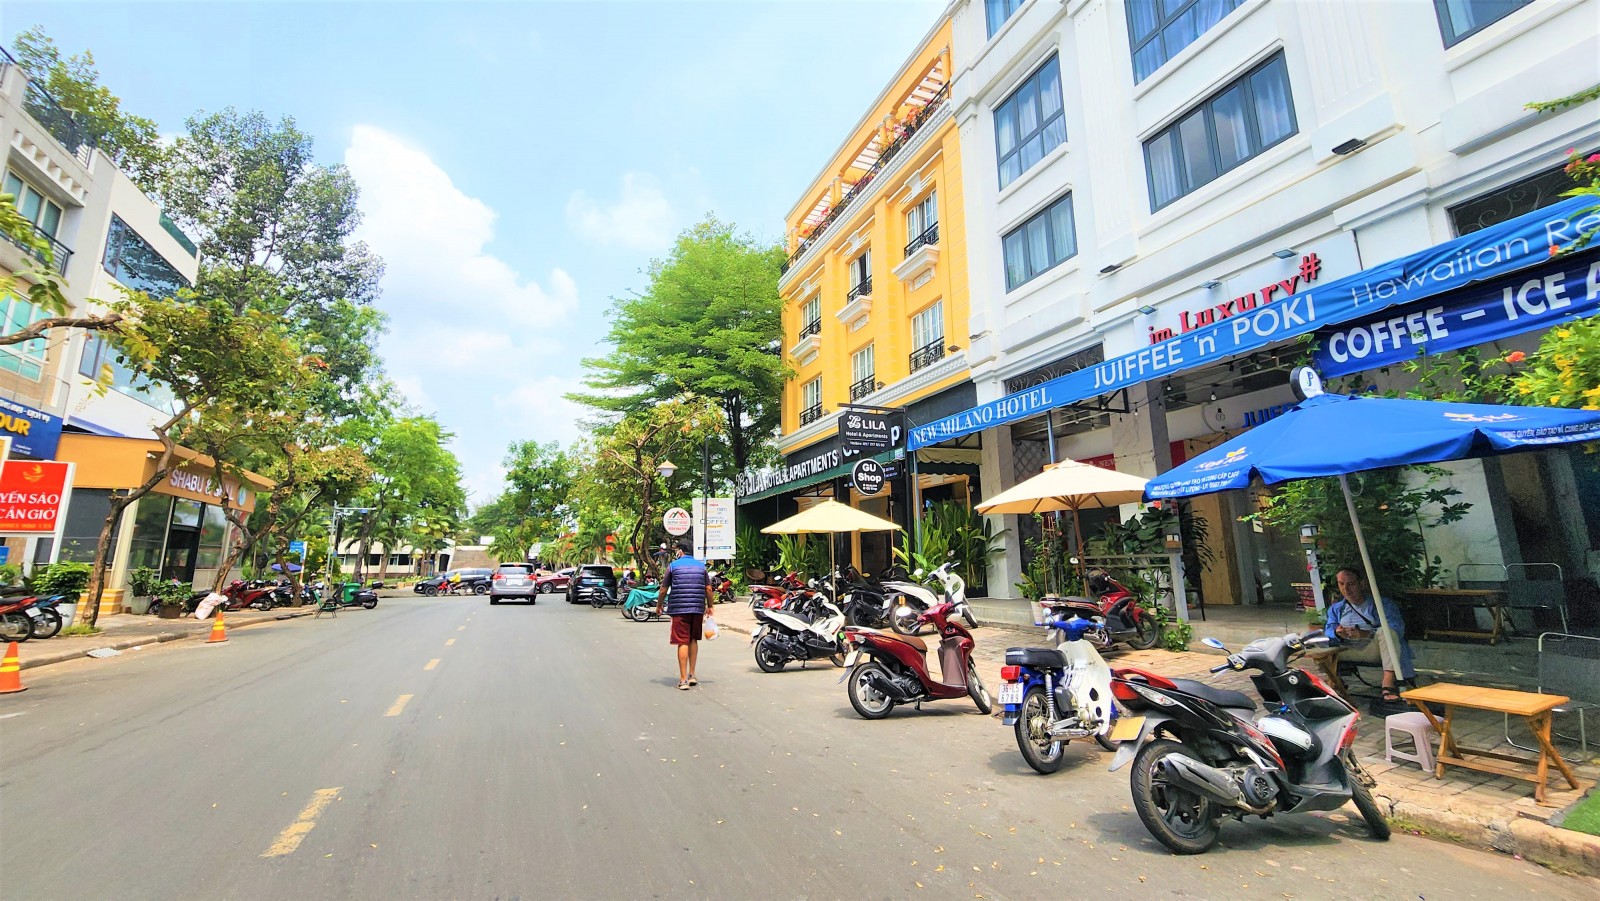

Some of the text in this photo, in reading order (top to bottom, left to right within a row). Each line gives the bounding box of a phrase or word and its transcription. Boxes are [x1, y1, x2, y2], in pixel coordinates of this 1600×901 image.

[1351, 237, 1530, 308] Hawaiian
[1328, 306, 1449, 363] COFFEE
[1502, 271, 1571, 321] ICE
[1094, 340, 1184, 389] JUIFFEE
[1231, 293, 1316, 346] POKI
[862, 419, 886, 430] LILA
[913, 424, 937, 445] NEW
[940, 406, 992, 436] MILANO
[996, 387, 1052, 419] HOTEL
[765, 471, 783, 488] HOTEL
[790, 449, 839, 481] APARTMENTS
[857, 472, 882, 483] Shop
[862, 463, 876, 472] GU
[170, 468, 204, 493] SHABU
[0, 490, 60, 505] YẾN SÀO
[27, 507, 56, 520] GIỜ
